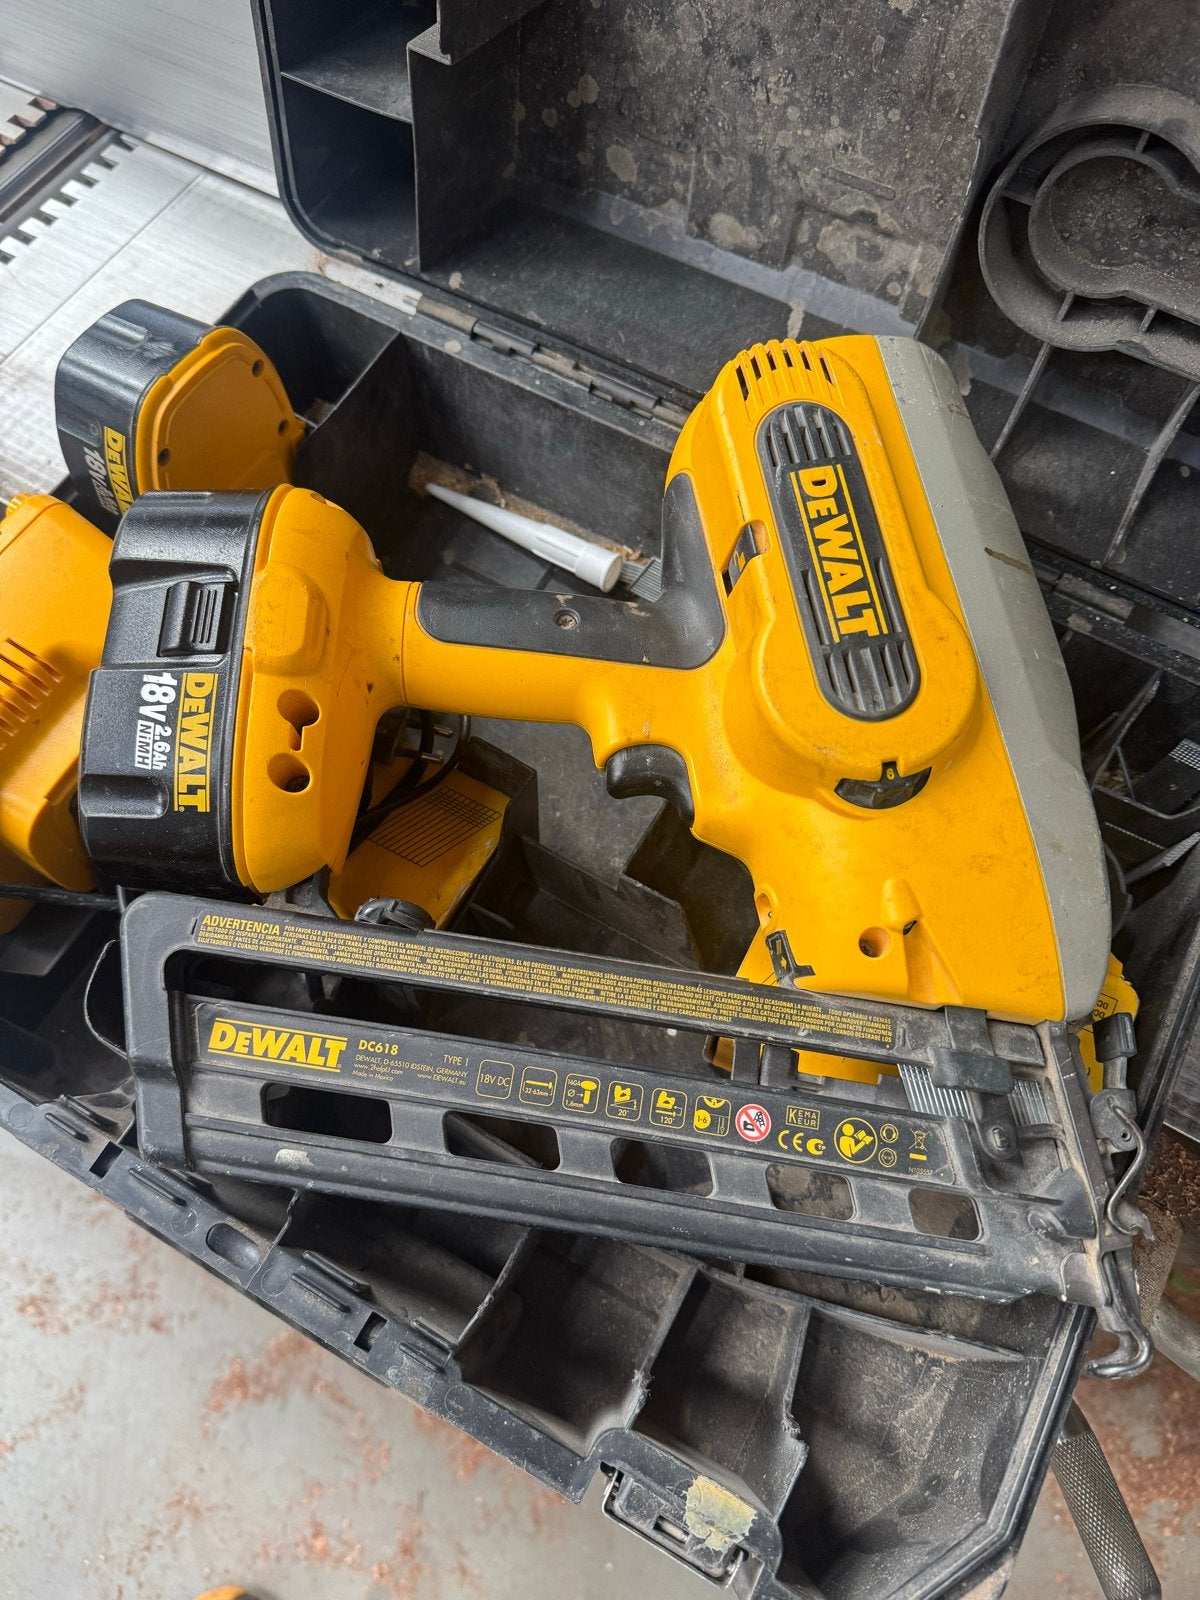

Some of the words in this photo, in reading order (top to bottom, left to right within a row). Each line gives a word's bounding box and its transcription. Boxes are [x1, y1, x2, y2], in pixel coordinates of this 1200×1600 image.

[83, 446, 108, 487] 18V
[799, 465, 881, 637] DEWALT
[139, 672, 178, 722] 18V
[136, 721, 154, 769] NiMH
[152, 724, 173, 771] 2.6Ah
[178, 672, 215, 812] DEWALT
[202, 914, 280, 935] ADVERTENCIA
[208, 1021, 347, 1070] DEWALT
[358, 1039, 399, 1056] DC618
[443, 1054, 463, 1066] TYPE
[351, 1070, 368, 1078] Made
[374, 1073, 394, 1082] Mexico
[383, 1058, 410, 1069] D-65510
[436, 1066, 469, 1077] GERMANY
[480, 1073, 497, 1084] 18V
[497, 1076, 511, 1087] DC
[697, 1115, 708, 1124] 1-6
